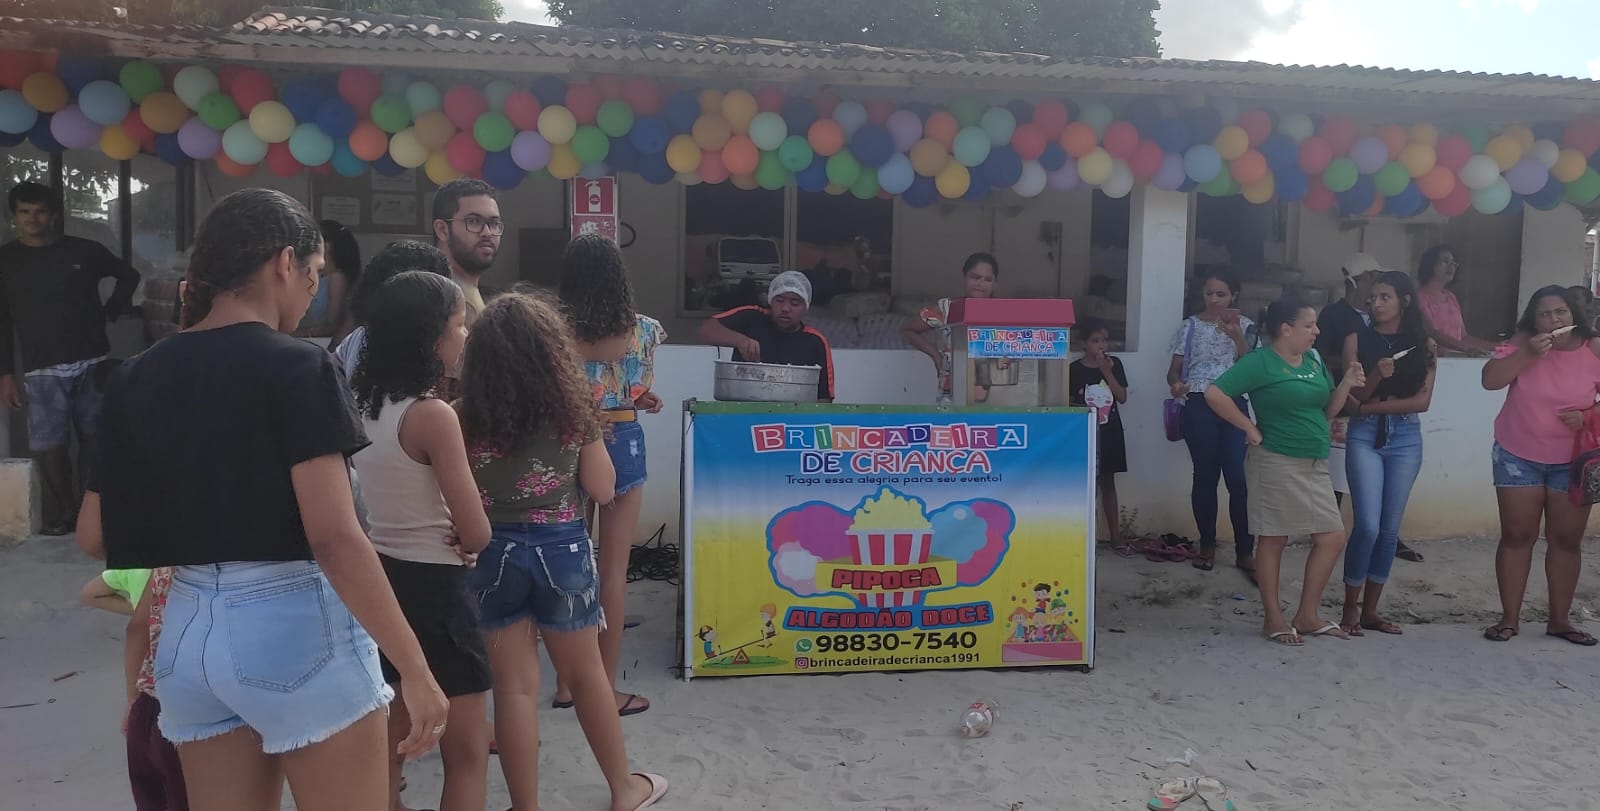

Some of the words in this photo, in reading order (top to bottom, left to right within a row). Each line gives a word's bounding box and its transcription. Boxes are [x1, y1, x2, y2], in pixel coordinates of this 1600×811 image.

[968, 329, 1067, 341] BRINCADEIRA
[984, 341, 1000, 352] DE
[755, 425, 1024, 450] BRINCADEIRA
[801, 451, 843, 474] DE
[850, 450, 991, 475] CRIANÇA
[785, 475, 820, 486] Traga
[858, 476, 899, 486] alegria
[903, 477, 933, 486] para
[960, 473, 1002, 483] evento!
[831, 566, 942, 590] PIPOCA
[787, 607, 913, 629] ALGODÃO
[920, 604, 990, 628] DOCE
[815, 631, 978, 654] 98830-7540
[810, 652, 980, 668] brincadeiradecrianca1991
